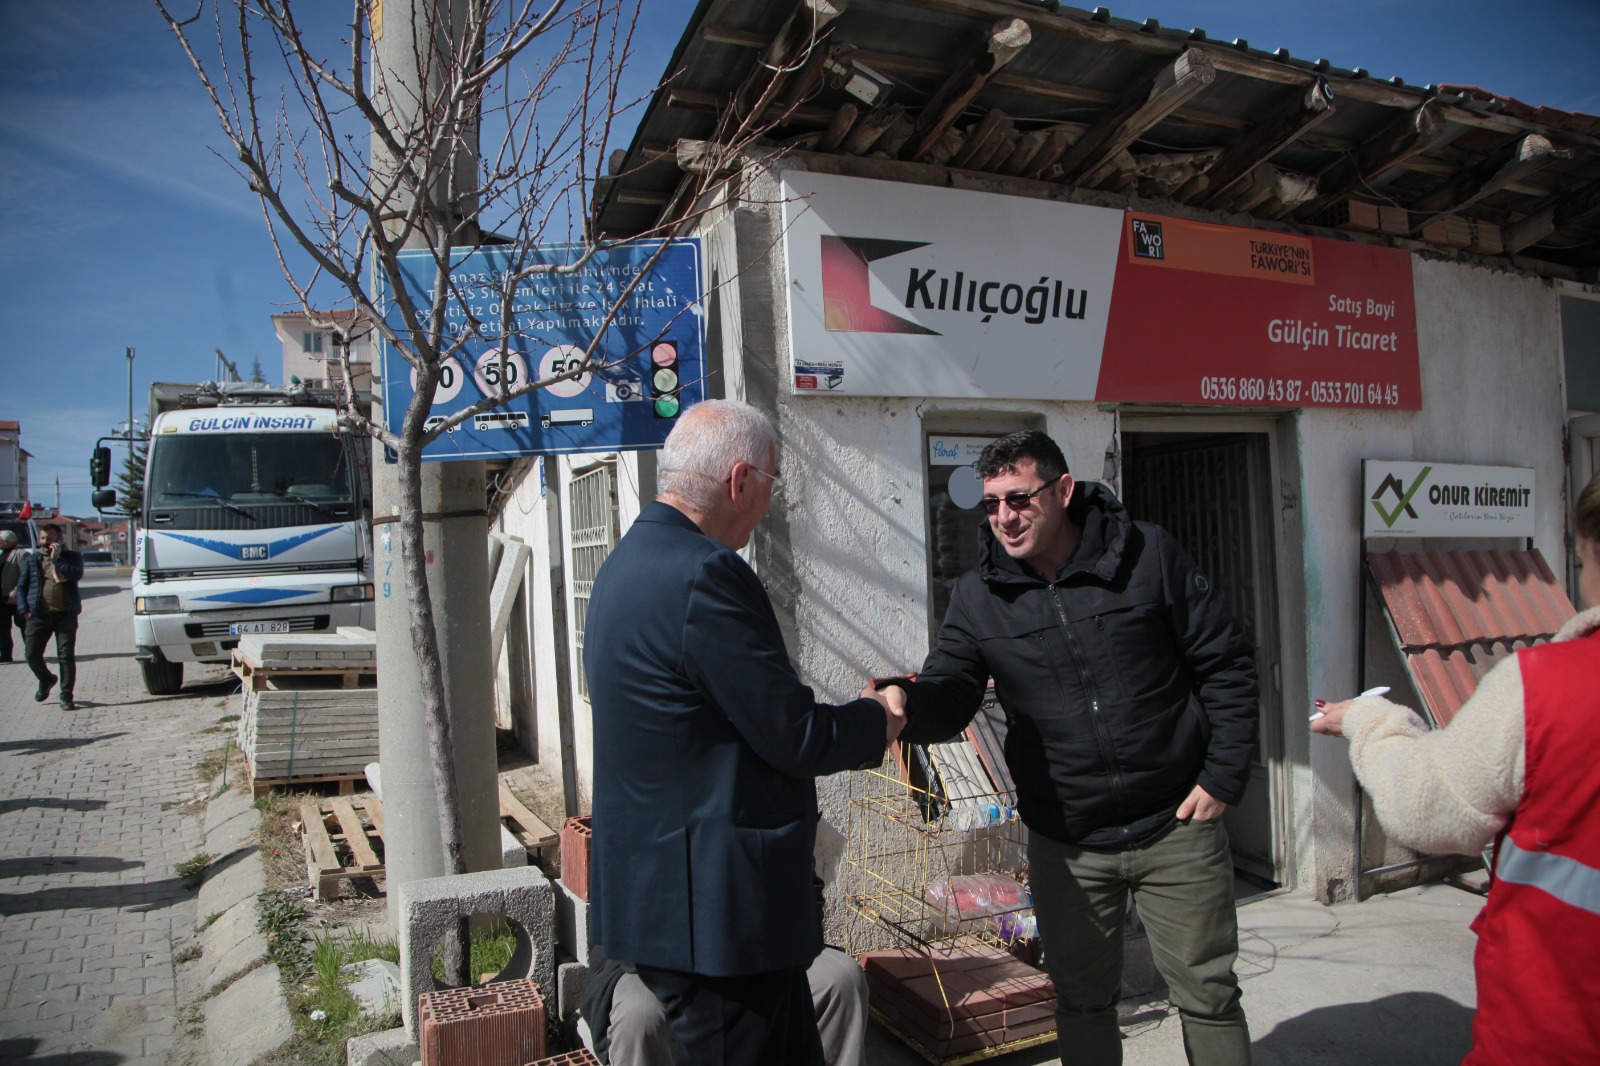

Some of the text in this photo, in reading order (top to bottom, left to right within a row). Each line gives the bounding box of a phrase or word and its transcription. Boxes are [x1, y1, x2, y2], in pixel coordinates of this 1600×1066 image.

[1133, 220, 1147, 233] FA
[1141, 233, 1161, 247] WO
[1148, 245, 1160, 258] RI
[448, 272, 486, 284] anaz
[570, 282, 590, 294] ile
[597, 281, 614, 294] 24
[904, 267, 1088, 325] Kılıçoğlu
[579, 299, 596, 310] ve
[1329, 294, 1395, 320] Satış Bayi
[1267, 318, 1398, 352] Gülçin Ticaret
[485, 361, 518, 386] 50
[551, 358, 583, 381] 50
[1201, 376, 1236, 400] 0536
[1239, 378, 1264, 401] 860
[1267, 378, 1284, 401] 43
[1286, 380, 1302, 402] 87
[1311, 381, 1342, 404] 0533
[1344, 383, 1364, 404] 701
[1367, 383, 1382, 405] 64
[1384, 384, 1399, 405] 45
[188, 415, 317, 431] GÜLÇİN İNŞAAT
[1429, 482, 1531, 508] ONUR KİREMİT
[241, 545, 267, 560] BMC
[237, 622, 288, 633] 64 AT 828
